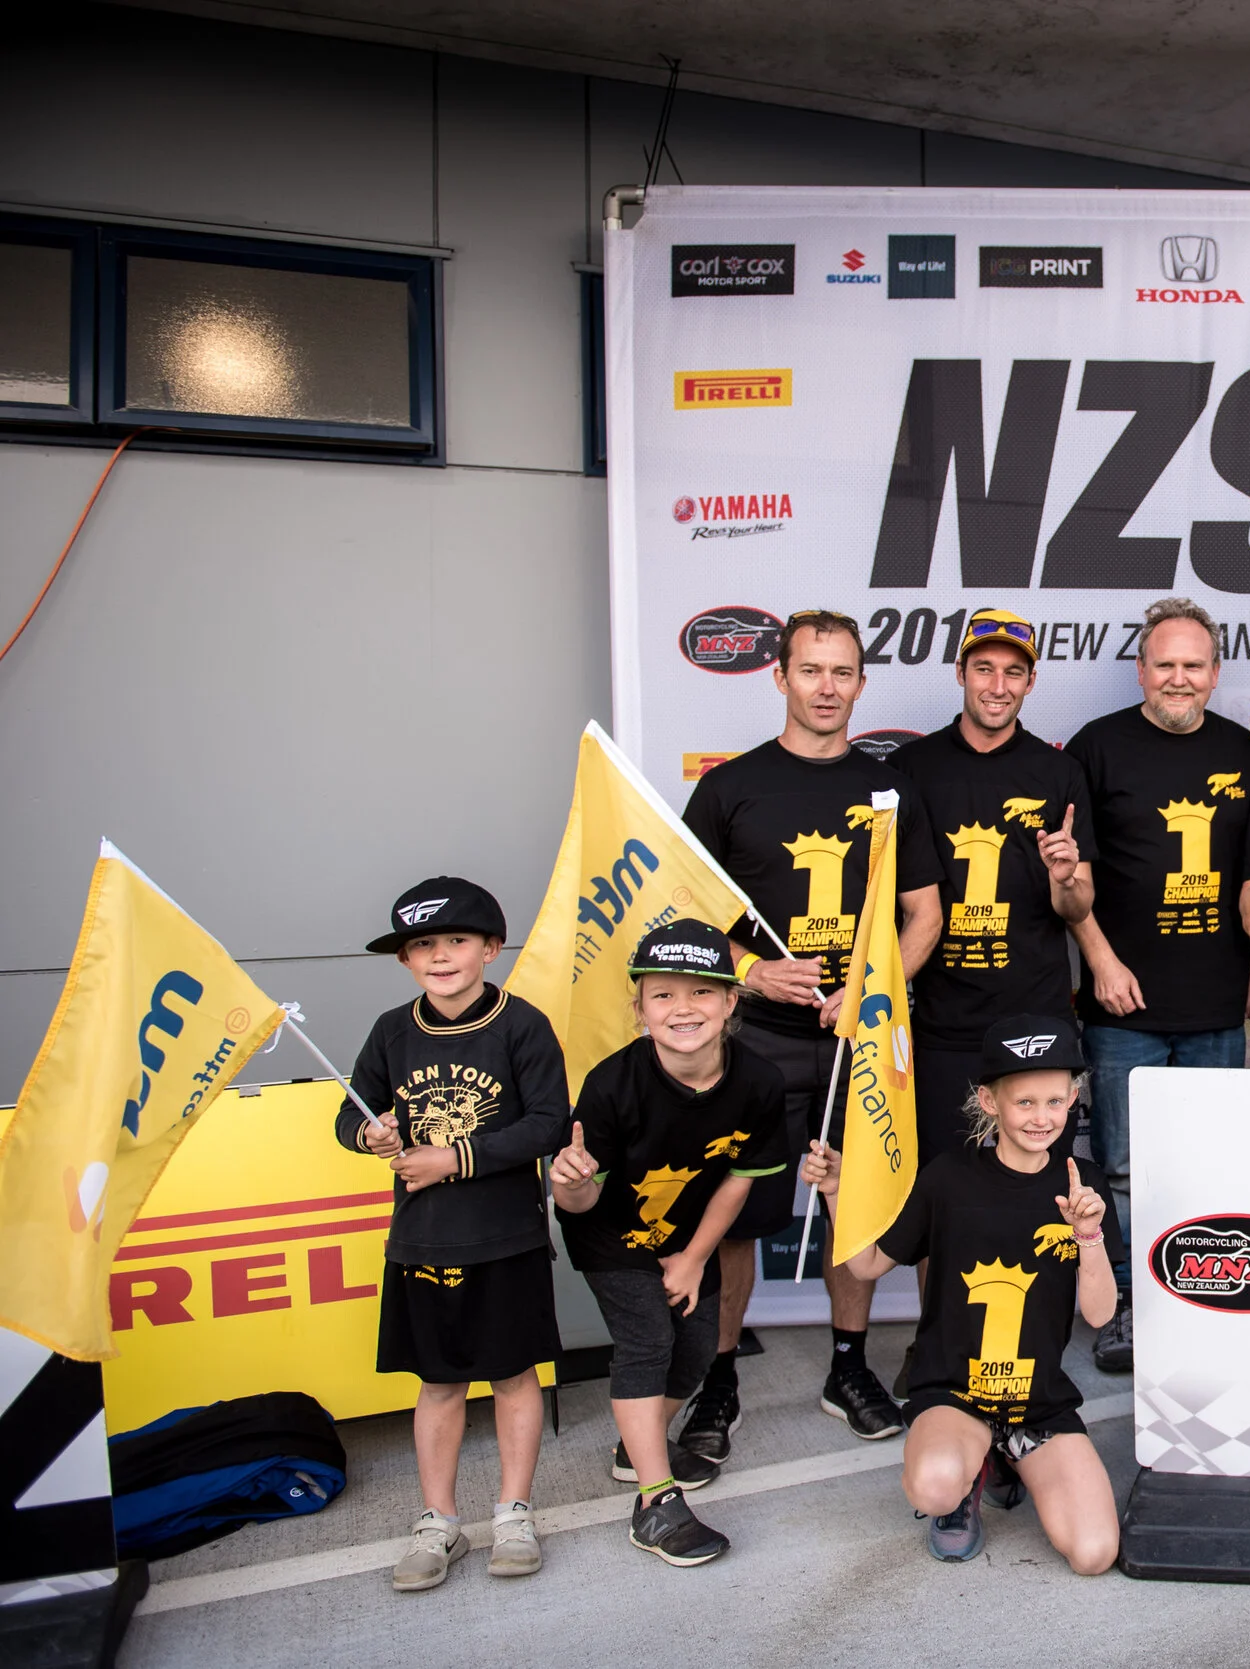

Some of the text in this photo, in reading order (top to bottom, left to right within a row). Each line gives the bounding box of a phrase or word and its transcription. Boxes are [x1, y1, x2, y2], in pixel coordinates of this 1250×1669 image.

[679, 255, 785, 276] carl cox
[898, 260, 946, 273] Way of Life!
[1030, 258, 1091, 276] PRINT
[698, 275, 767, 286] MOTOR SPORT
[826, 274, 881, 284] SUZUKI
[1136, 288, 1244, 304] HONDA
[683, 376, 782, 402] PIRELLI
[698, 493, 793, 521] YAMAHA
[691, 522, 784, 540] Revs Your Heart
[695, 635, 755, 652] MNZ
[864, 607, 996, 665] 201
[1181, 873, 1209, 885] 2019
[1164, 886, 1220, 899] CHAMPION
[964, 905, 993, 917] 2019
[807, 917, 839, 931] 2019
[949, 917, 1008, 931] CHAMPION
[788, 931, 854, 947] CHAMPION
[649, 943, 720, 965] Kawasaki
[656, 954, 684, 962] Team
[449, 1063, 502, 1098] YOUR
[851, 1039, 902, 1174] finance
[771, 1243, 789, 1255] Way
[1175, 1236, 1248, 1248] MOTORCYCLING
[443, 1267, 462, 1276] NGK
[1177, 1281, 1231, 1291] NEW ZEALAND
[980, 1361, 1015, 1377] 2019
